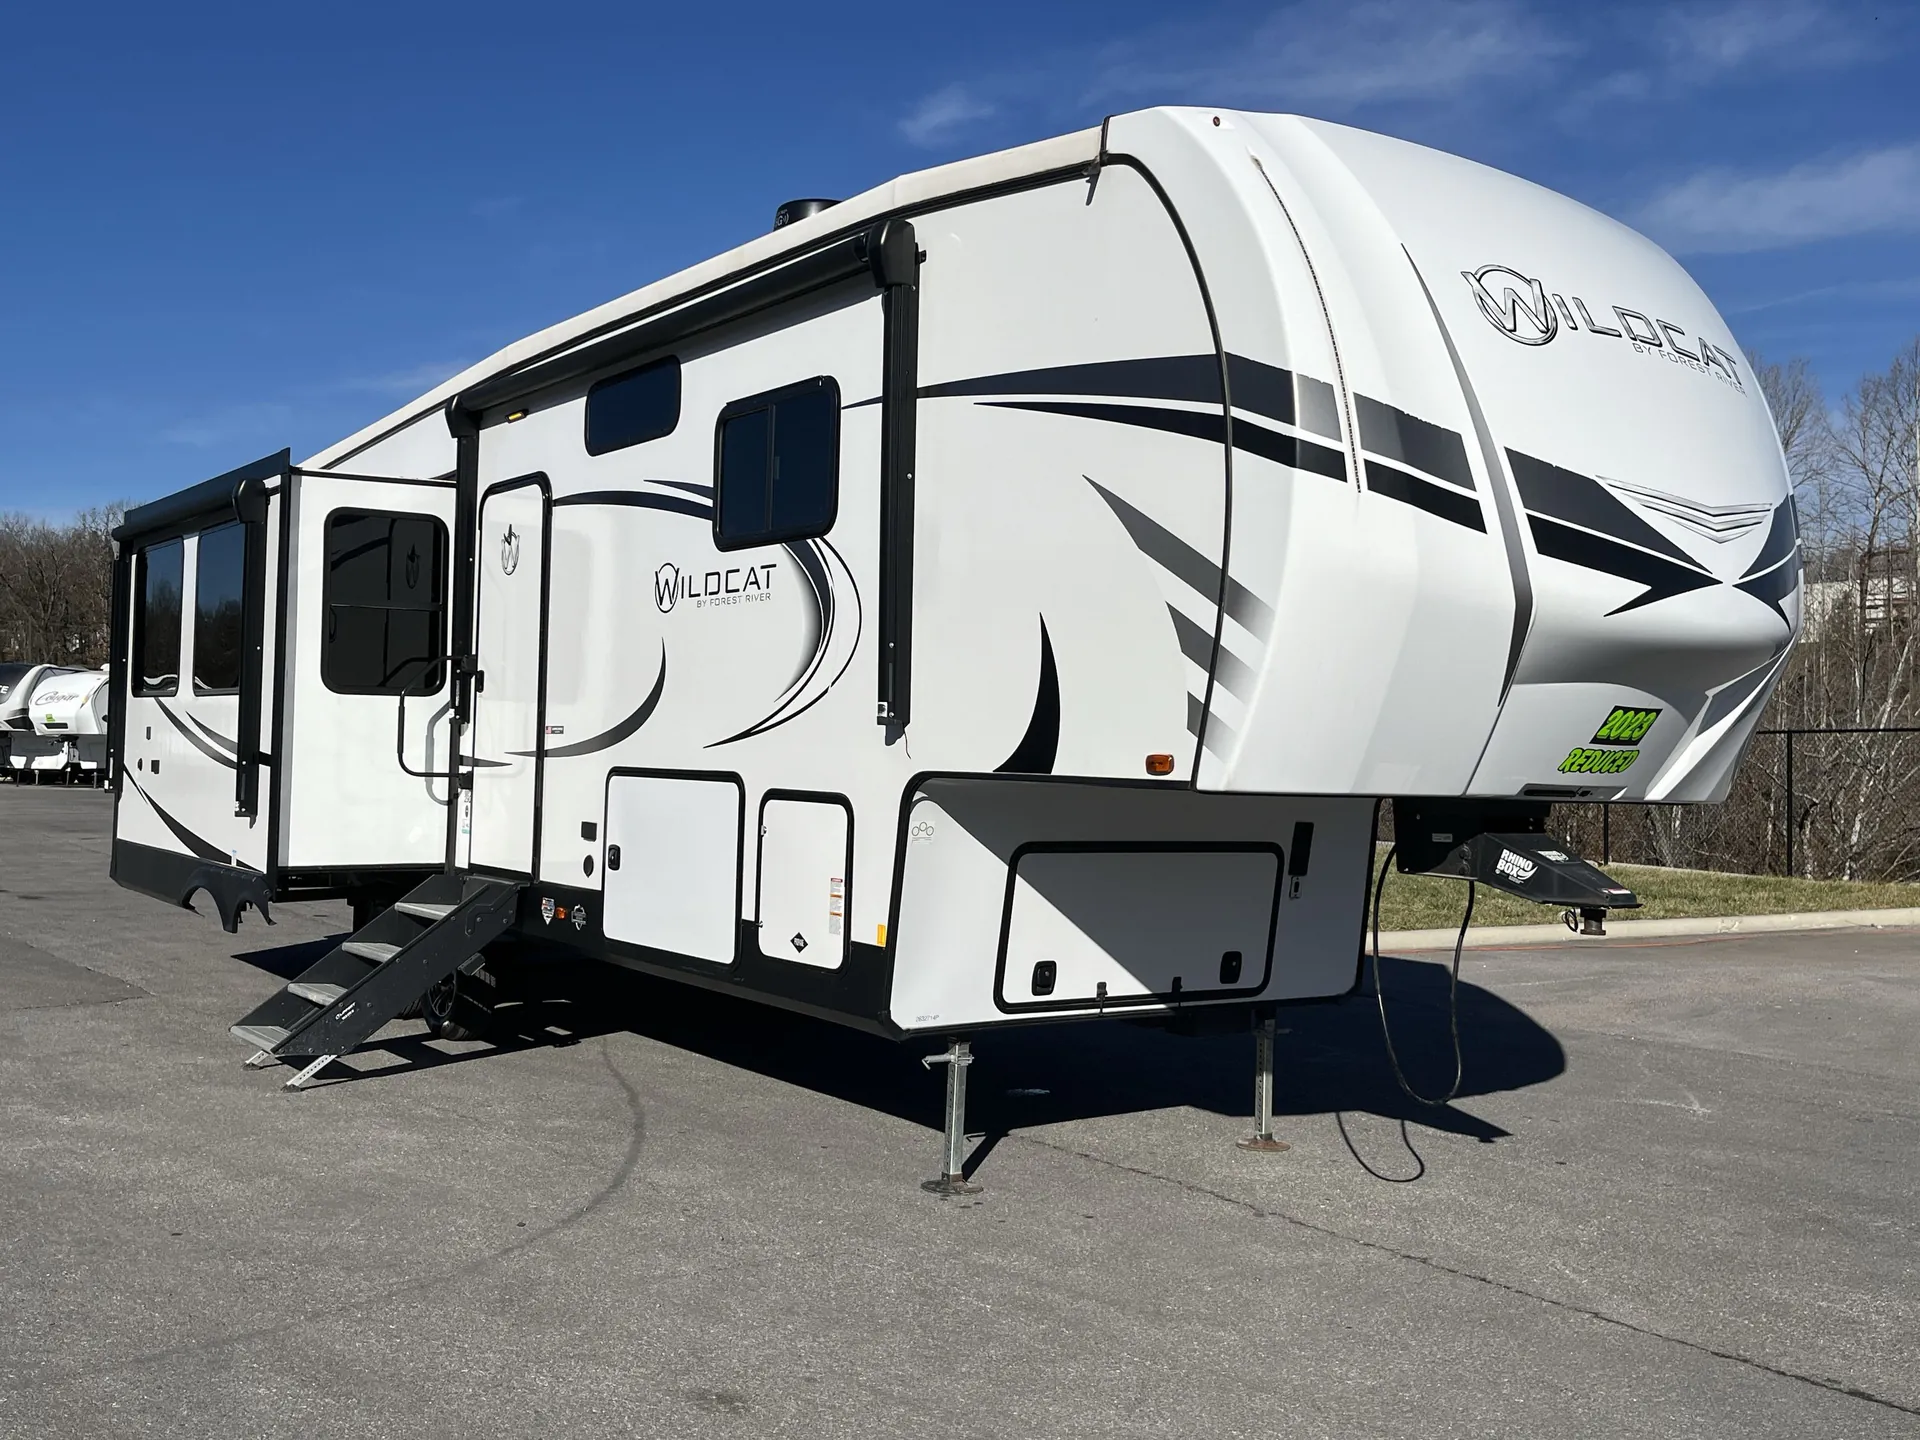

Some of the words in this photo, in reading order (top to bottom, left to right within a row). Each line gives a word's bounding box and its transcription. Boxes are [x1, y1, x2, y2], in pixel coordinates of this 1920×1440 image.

[1460, 264, 1742, 386] WILDCAT
[1632, 342, 1652, 355] BY
[1658, 349, 1712, 376] FOREST
[1715, 371, 1748, 397] RIVER
[654, 562, 777, 613] WILDCAT
[696, 599, 707, 609] BY
[709, 595, 742, 607] FOREST
[745, 592, 772, 604] RIVER
[35, 690, 79, 706] Cougar
[1596, 709, 1657, 741] 2023
[1557, 747, 1640, 774] REDUCED
[1496, 858, 1520, 878] BOX
[1500, 848, 1533, 872] RHINO
